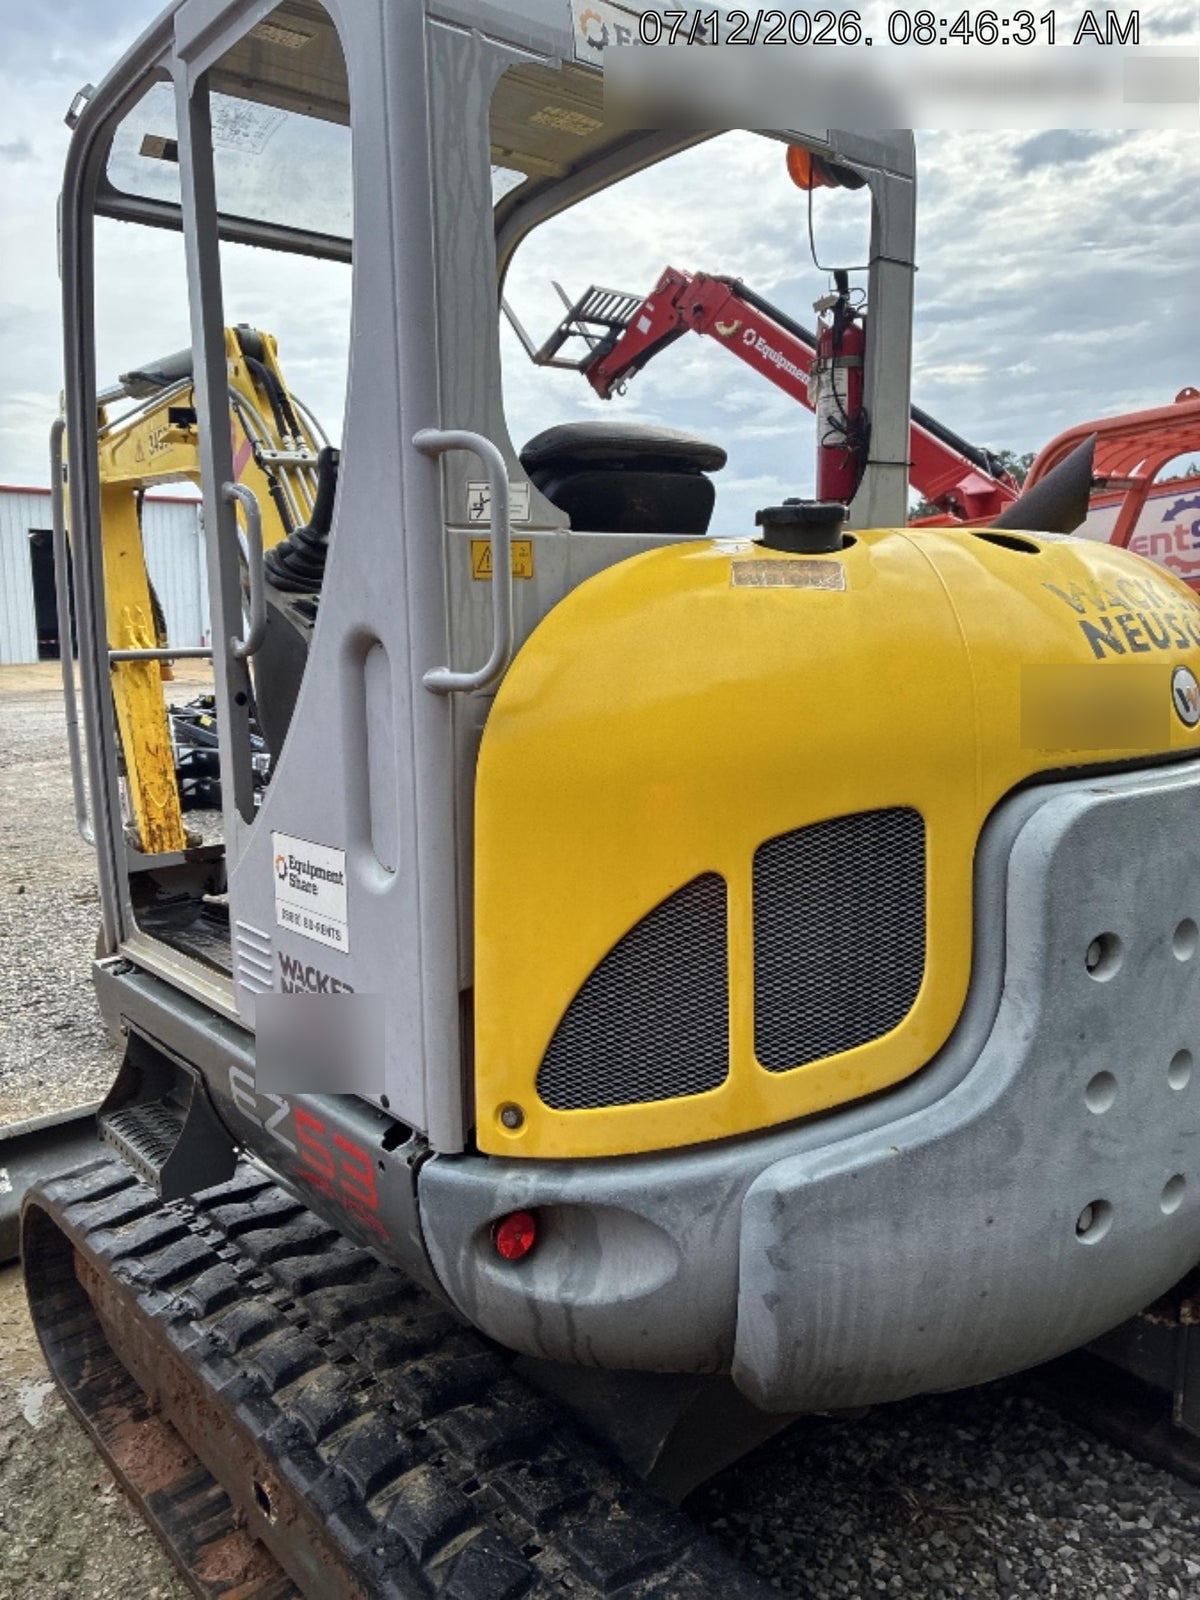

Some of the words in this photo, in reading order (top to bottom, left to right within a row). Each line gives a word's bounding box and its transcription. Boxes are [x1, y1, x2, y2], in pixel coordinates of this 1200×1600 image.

[755, 335, 810, 386] Equipmen
[288, 854, 344, 886] Equipment
[289, 872, 319, 896] Share
